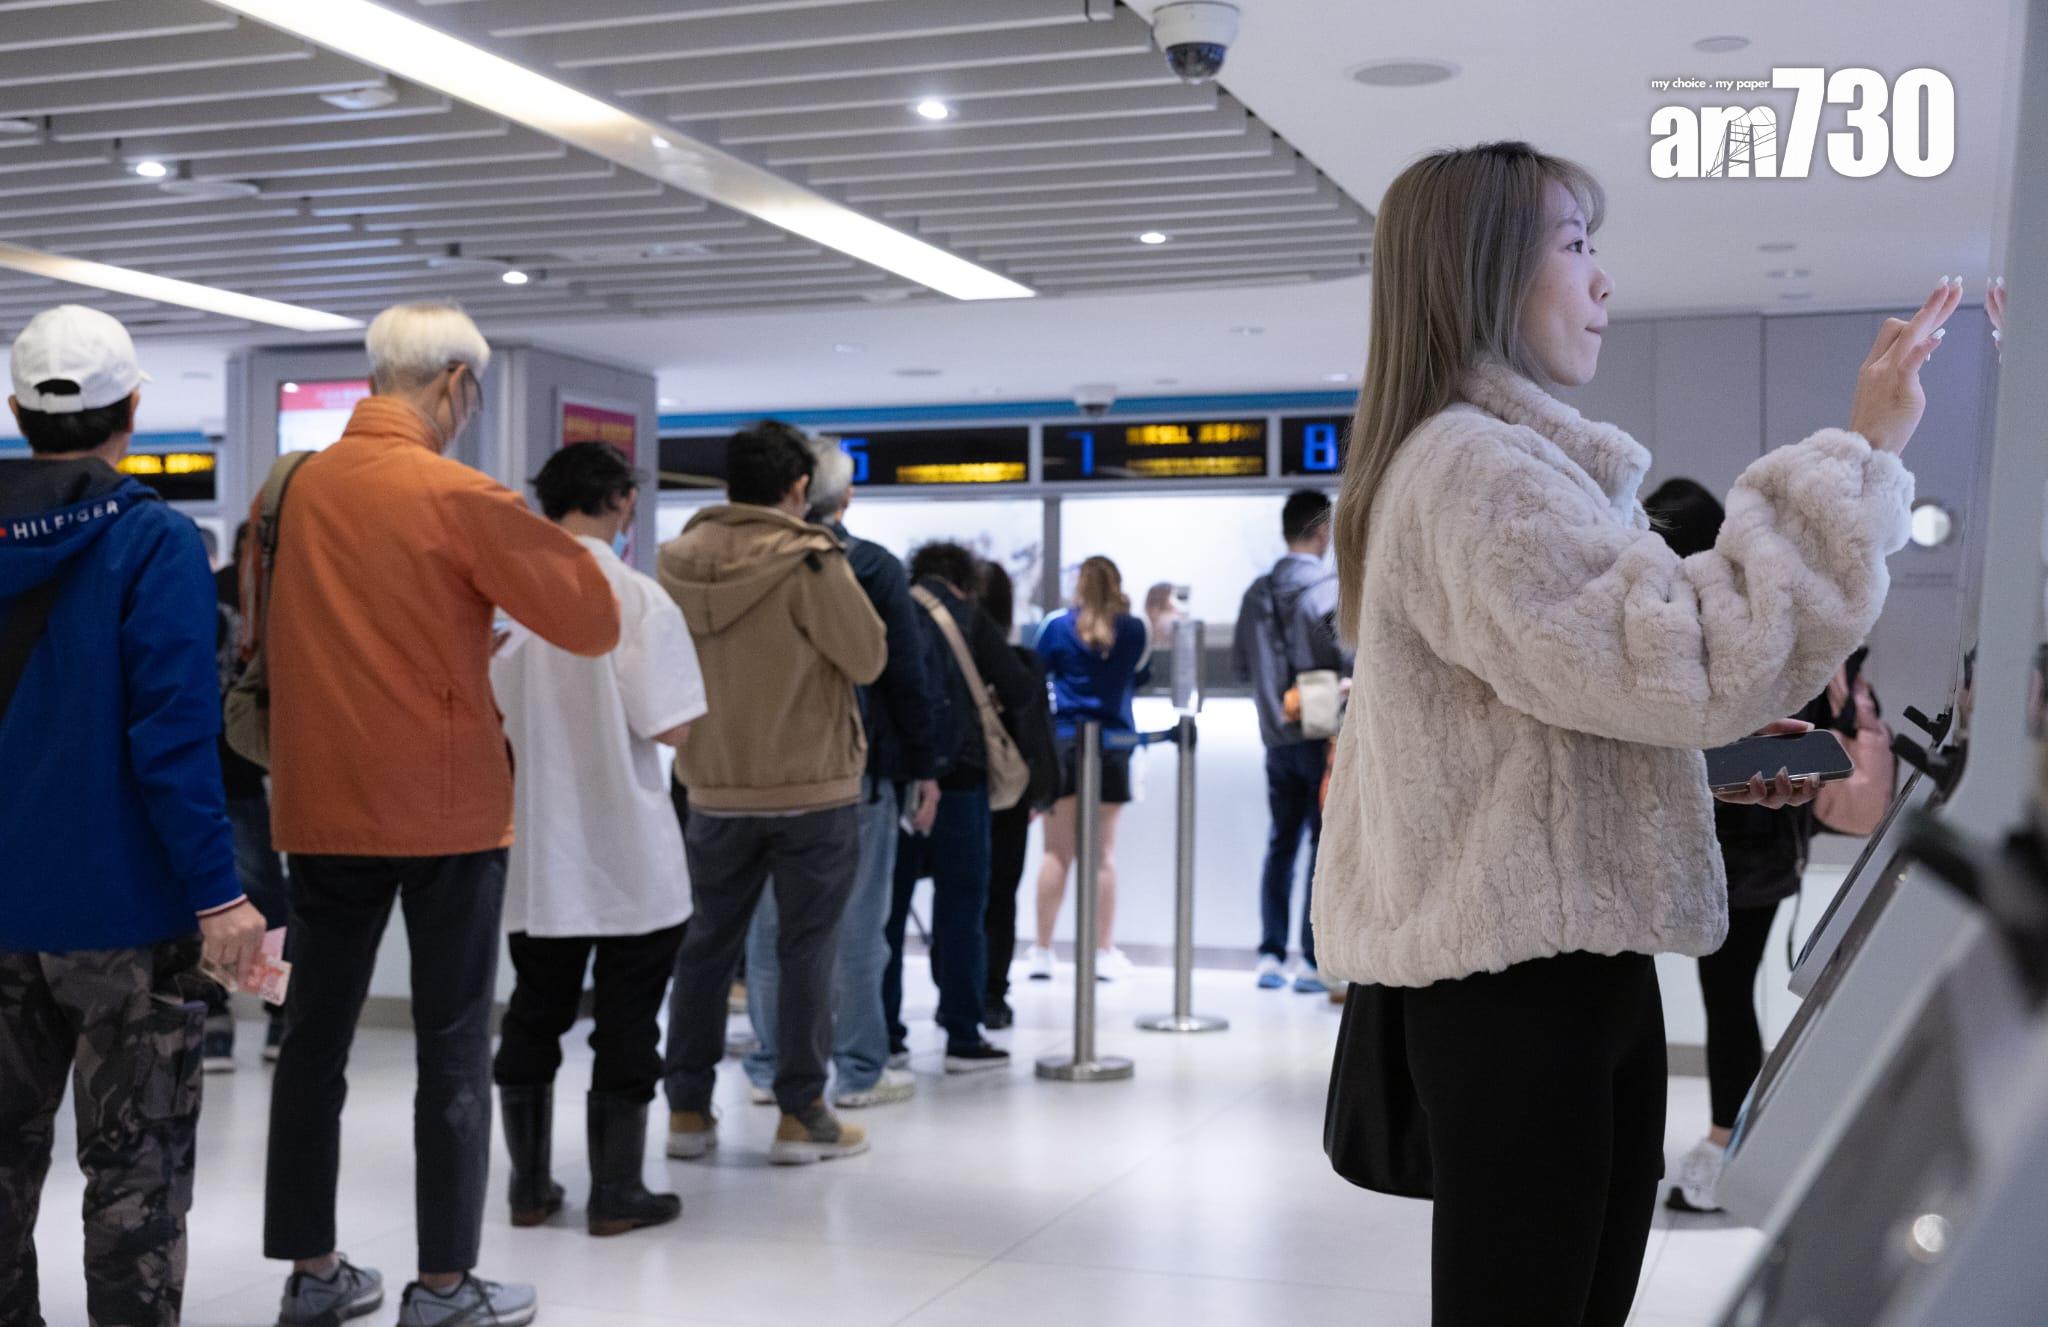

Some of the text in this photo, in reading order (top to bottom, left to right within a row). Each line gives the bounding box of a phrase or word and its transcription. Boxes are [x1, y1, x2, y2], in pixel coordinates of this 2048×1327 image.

[1067, 431, 1095, 476] 7
[1304, 424, 1338, 470] 8
[12, 500, 119, 540] HILFIGER
